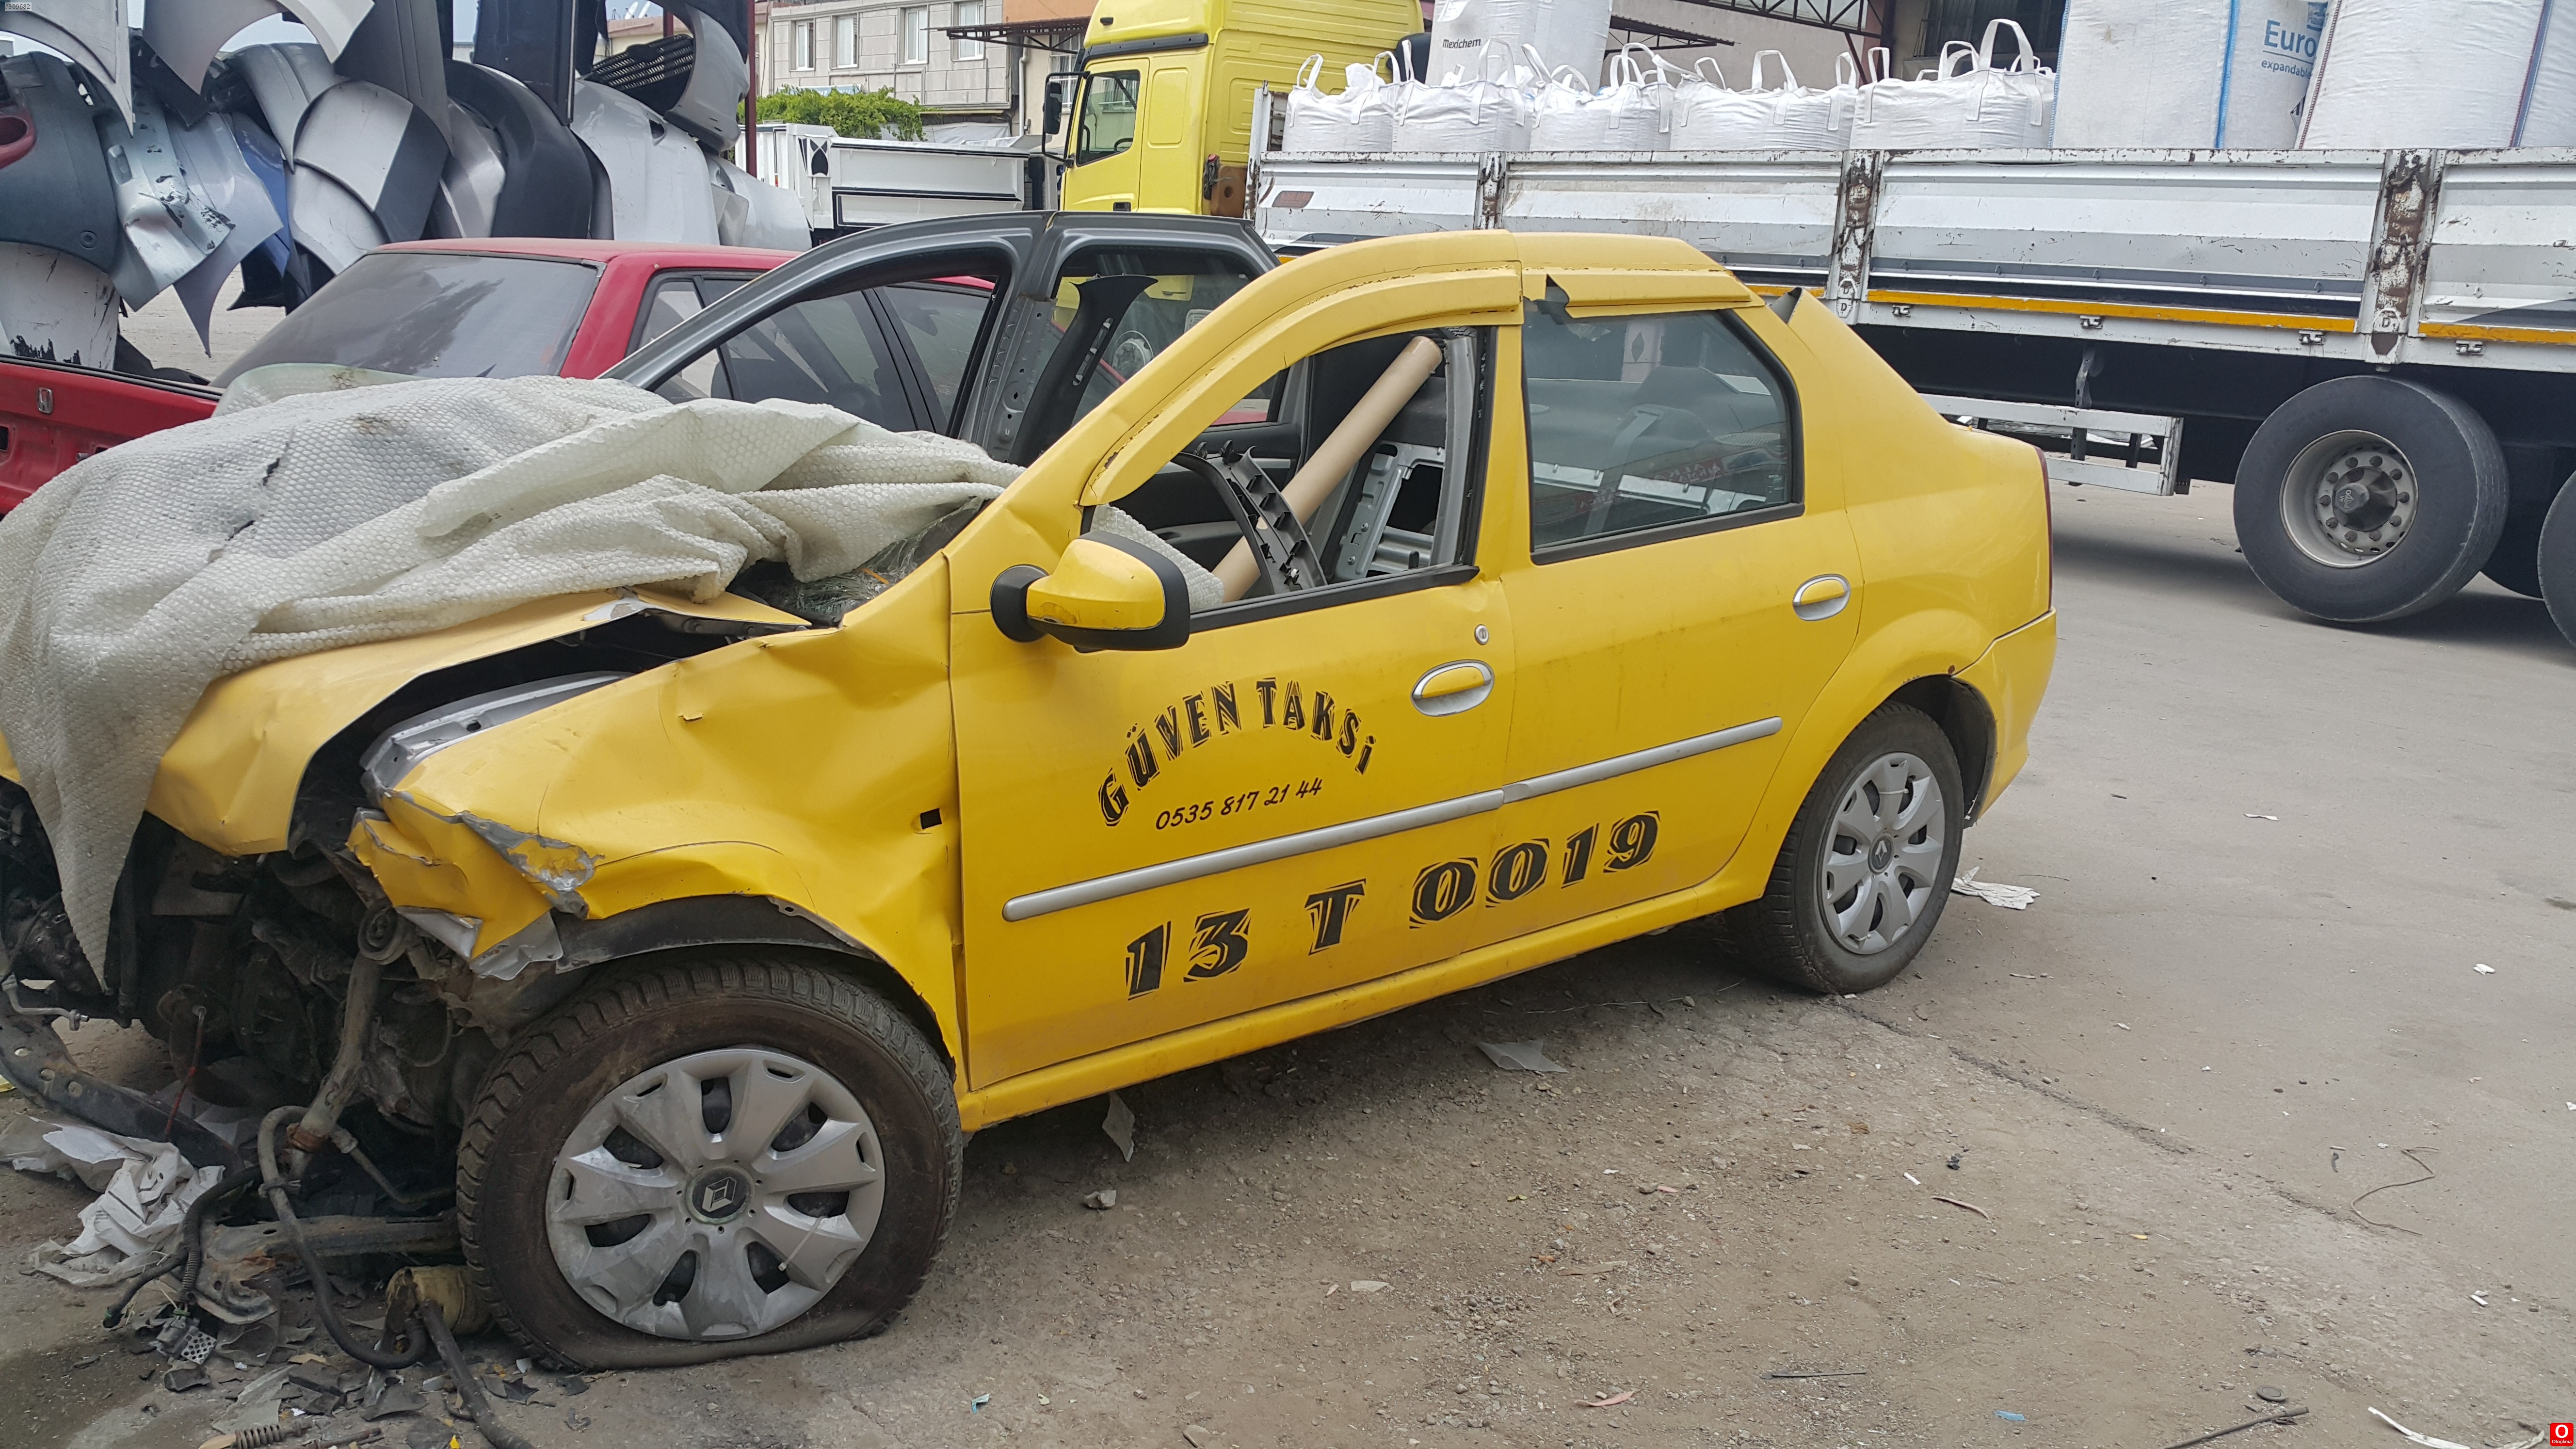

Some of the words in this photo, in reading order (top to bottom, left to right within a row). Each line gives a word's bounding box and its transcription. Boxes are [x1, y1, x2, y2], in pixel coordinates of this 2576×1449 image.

[1442, 38, 1481, 48] Mexichem
[2264, 19, 2317, 57] Euro
[2261, 60, 2311, 80] expandable
[1098, 681, 1242, 826] GÜVEN
[1156, 800, 1214, 830] 0535
[1221, 790, 1260, 816] 817
[1264, 784, 1290, 806] 21
[1295, 777, 1322, 799] 44
[1125, 908, 1251, 1000] 13
[1304, 878, 1367, 956] T
[1409, 810, 1660, 929] 0019
